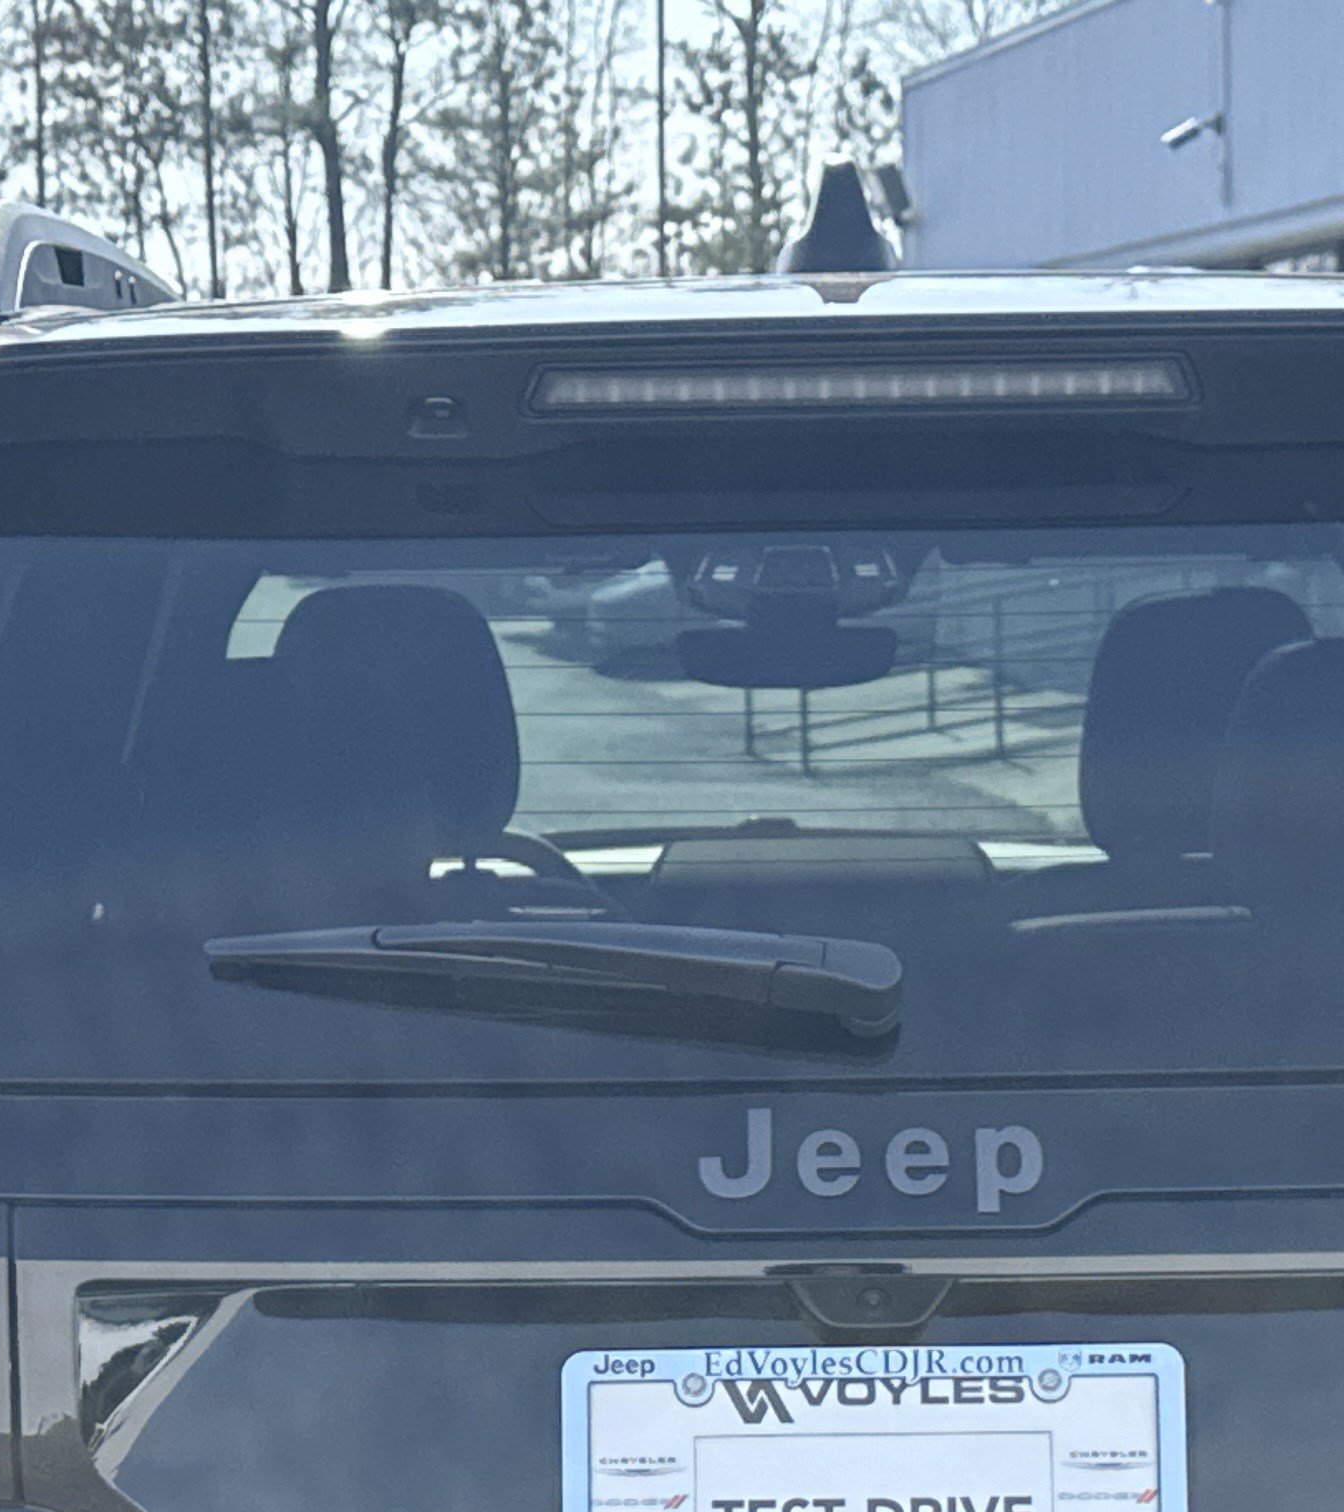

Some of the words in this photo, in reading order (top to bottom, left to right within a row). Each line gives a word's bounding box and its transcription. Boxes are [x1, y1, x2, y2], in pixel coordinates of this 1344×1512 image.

[698, 1107, 1043, 1213] Jeep
[592, 1353, 655, 1378] Jeep
[705, 1348, 1024, 1380] EdVoylesCDJR.com
[1087, 1353, 1152, 1365] RAM
[799, 1376, 1026, 1406] VOYLES
